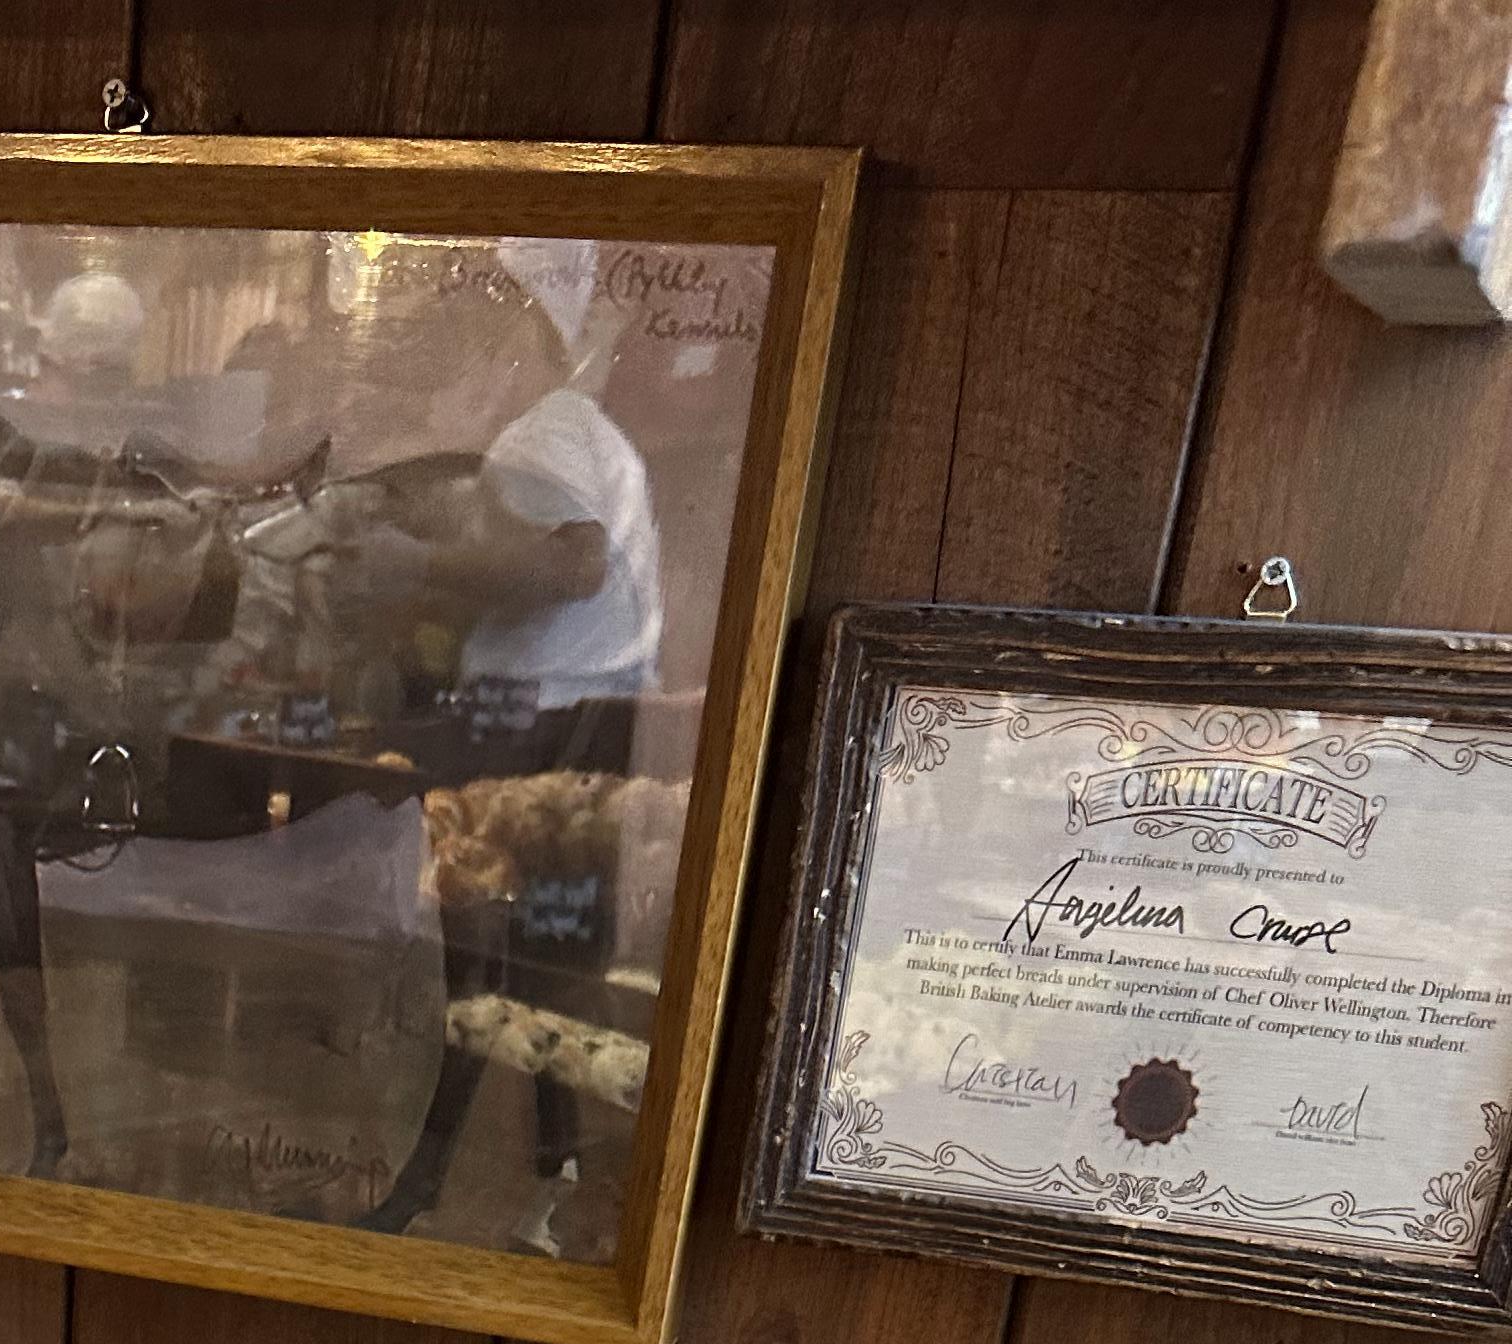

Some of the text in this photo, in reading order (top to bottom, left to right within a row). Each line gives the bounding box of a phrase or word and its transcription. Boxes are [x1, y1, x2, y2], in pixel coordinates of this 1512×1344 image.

[1121, 766, 1333, 824] CERTIFICATE
[1078, 848, 1344, 887] This certificate is proudly presented to
[905, 929, 1511, 1005] This is to certify that Emma Lawrence has successfully completed the Diploma in
[906, 956, 1497, 1030] making perfect breads under supervision of Chef Oliver Wellington. Therefore
[920, 979, 966, 999] British
[970, 984, 1020, 1008] Baking
[1023, 991, 1072, 1010] Atelier
[1075, 1001, 1127, 1016] awards
[1131, 1002, 1155, 1018] the
[1159, 1008, 1232, 1028] certificate
[1236, 1014, 1254, 1030] of
[1257, 1019, 1351, 1043] competency
[1355, 1031, 1370, 1043] to
[1375, 1029, 1402, 1046] this
